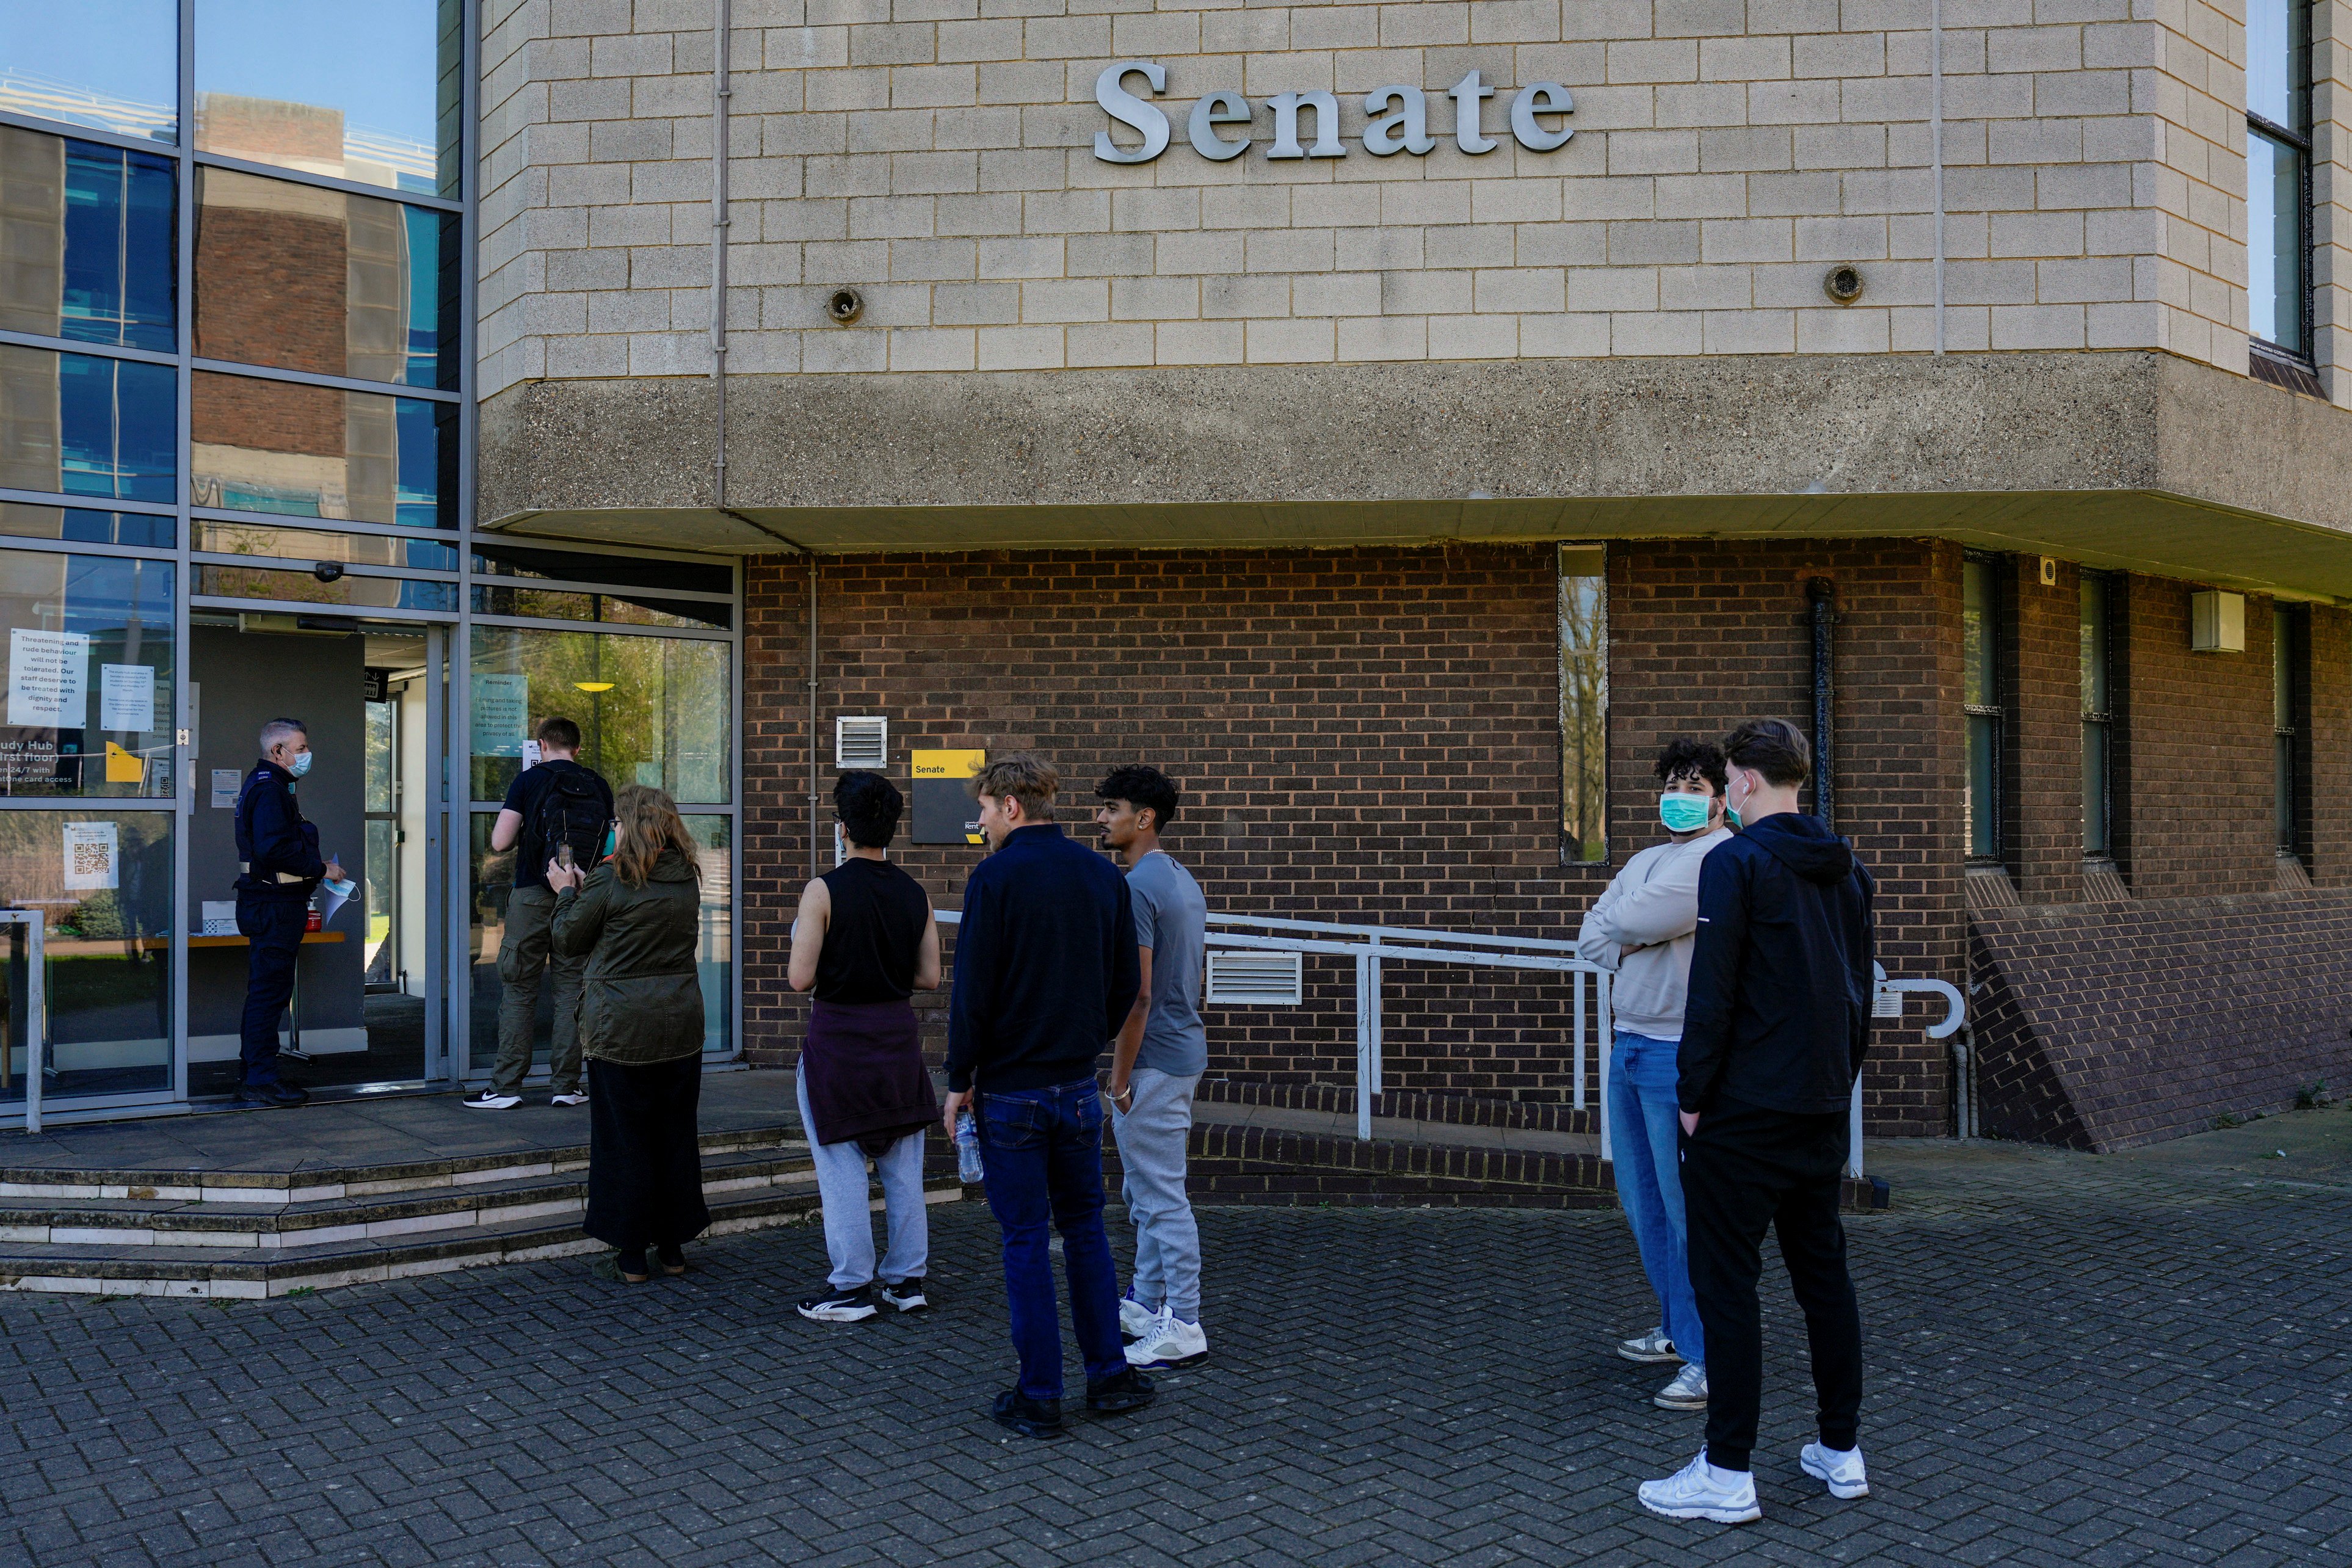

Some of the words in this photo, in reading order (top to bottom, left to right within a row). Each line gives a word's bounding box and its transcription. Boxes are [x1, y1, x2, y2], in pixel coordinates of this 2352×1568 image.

[1094, 61, 1575, 165] Senate
[21, 636, 64, 646] Threatening
[28, 741, 53, 750] Hub
[24, 752, 59, 763] floor)
